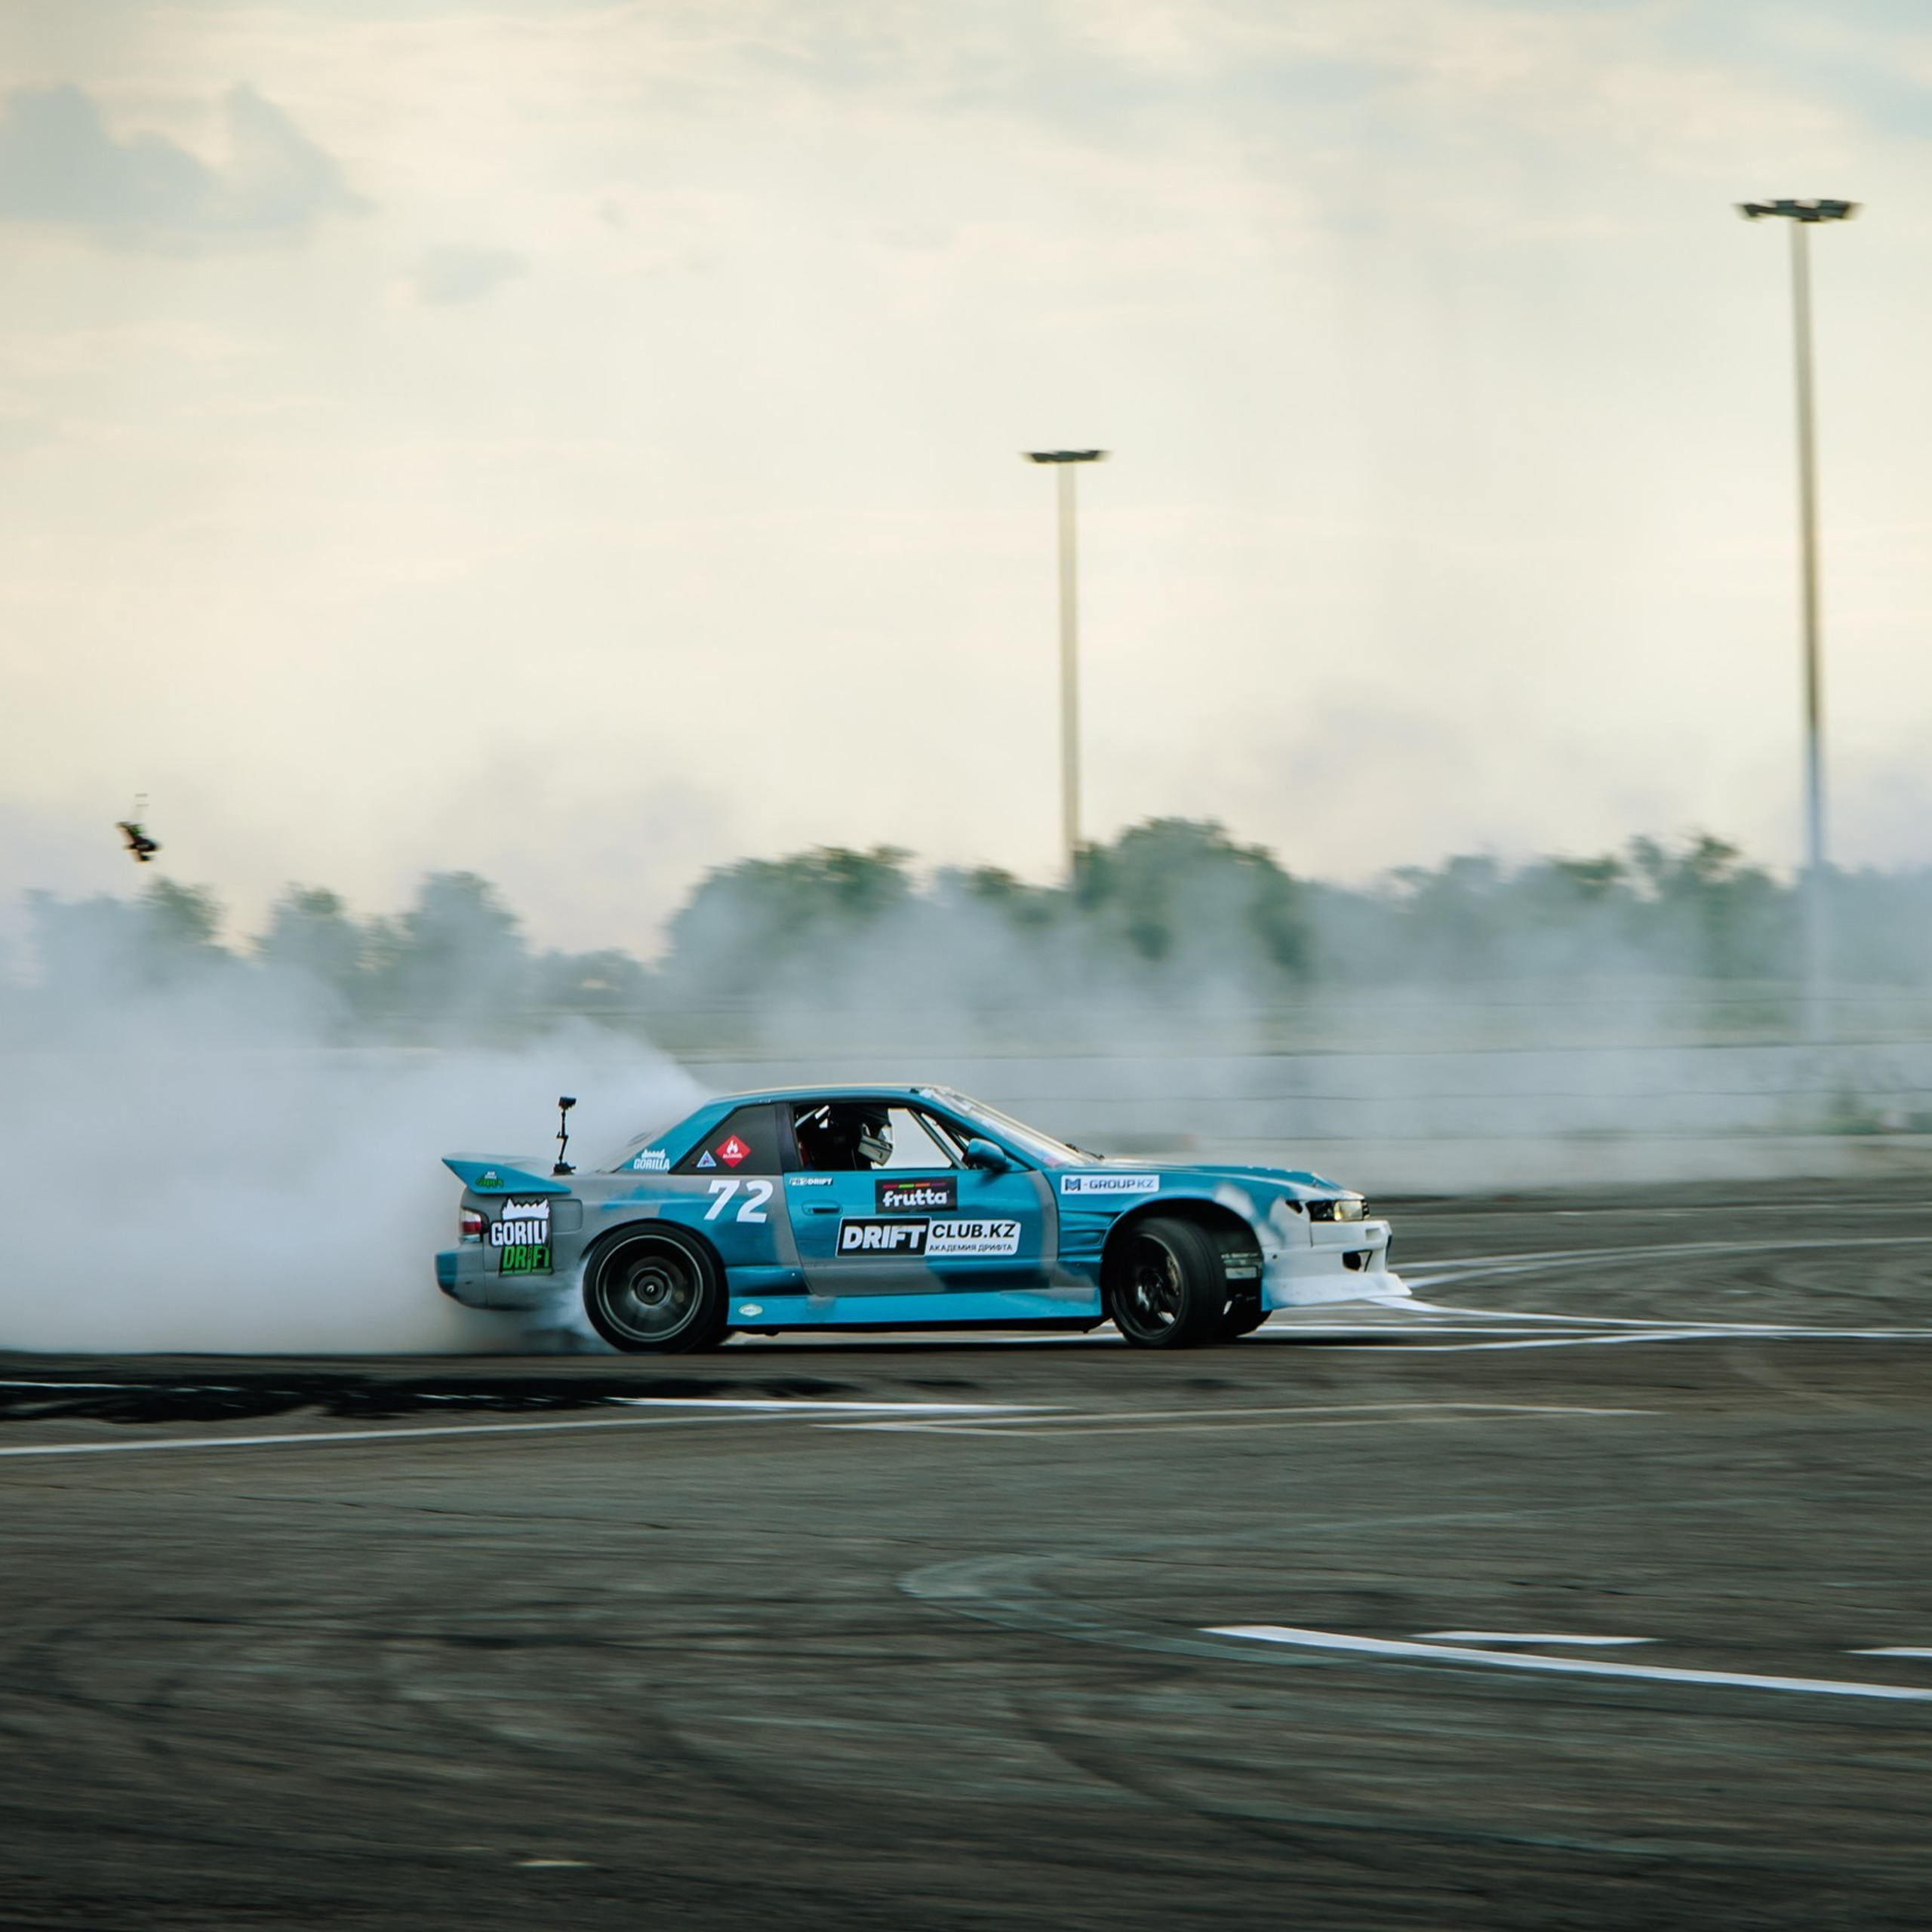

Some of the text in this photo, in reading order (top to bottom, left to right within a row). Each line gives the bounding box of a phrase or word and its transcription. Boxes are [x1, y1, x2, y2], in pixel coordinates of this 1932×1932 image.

[633, 1158, 670, 1170] GORILLA
[703, 1180, 774, 1223] 72
[841, 1223, 1017, 1249] DRIFT CLUB.KZ
[929, 1244, 1013, 1253] АКАДЕМИЯ ДРИФТА
